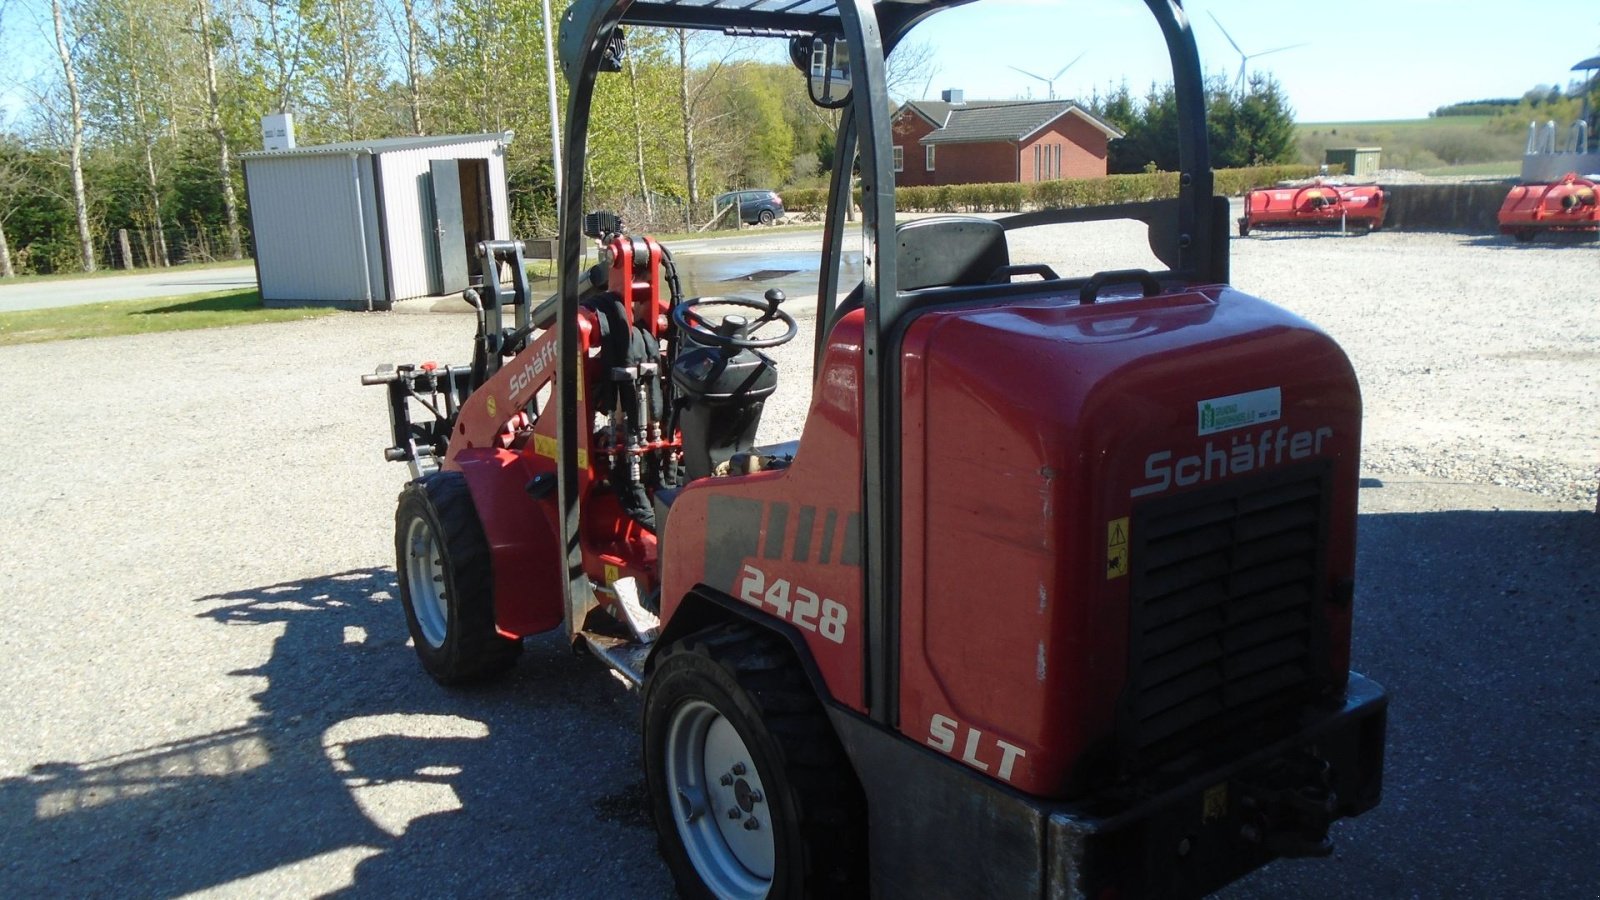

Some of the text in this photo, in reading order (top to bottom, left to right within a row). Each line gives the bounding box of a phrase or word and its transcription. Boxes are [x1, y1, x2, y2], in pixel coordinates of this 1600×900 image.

[509, 340, 557, 400] Schäff
[1130, 426, 1334, 498] Schäffer
[741, 564, 848, 644] 2428
[927, 713, 1026, 781] SLT
